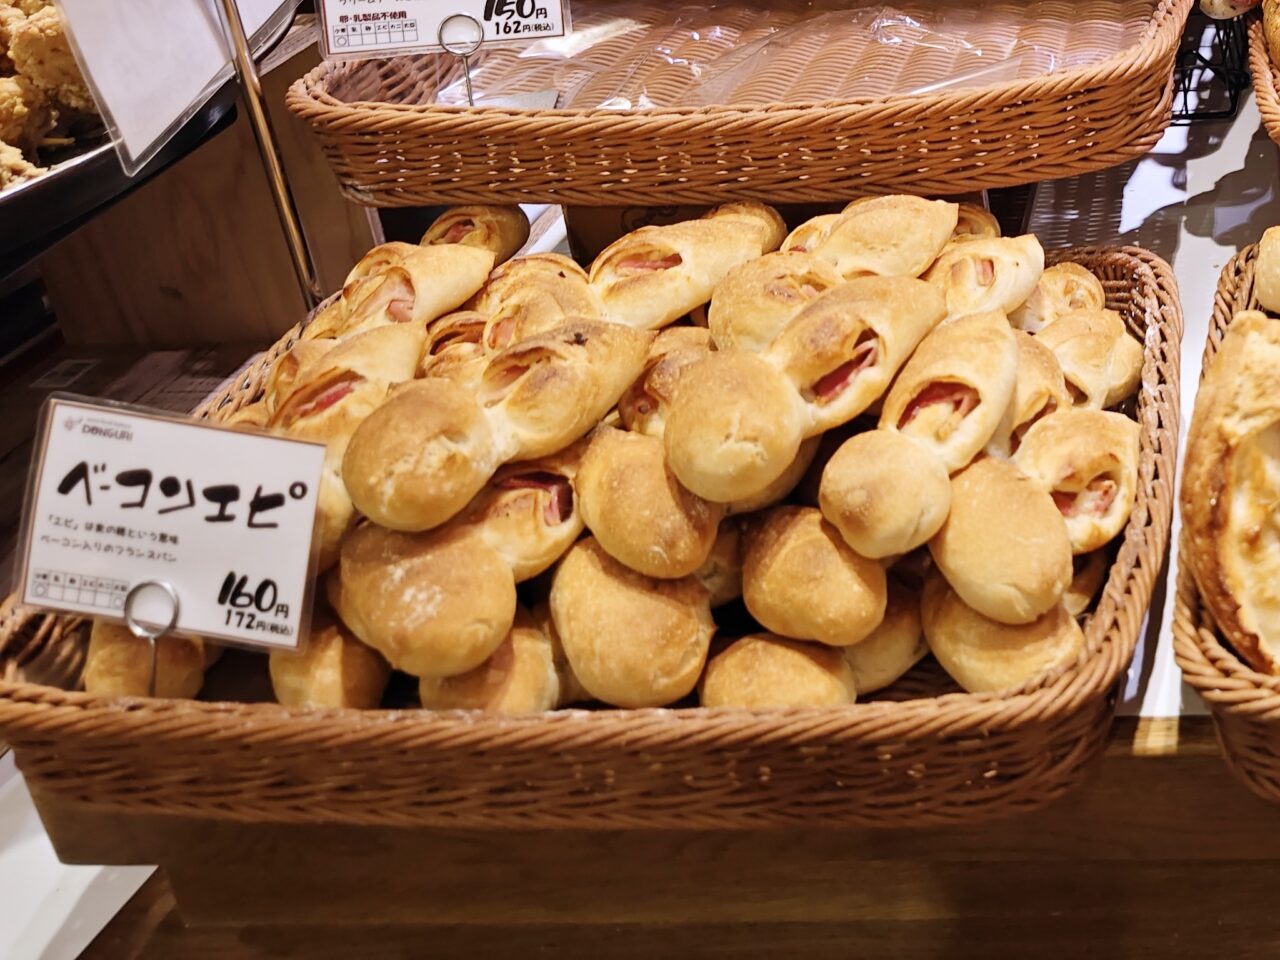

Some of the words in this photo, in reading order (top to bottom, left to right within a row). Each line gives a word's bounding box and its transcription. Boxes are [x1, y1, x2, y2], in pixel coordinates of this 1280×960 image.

[56, 460, 309, 529] ベーコンエピ
[217, 570, 290, 619] 160円
